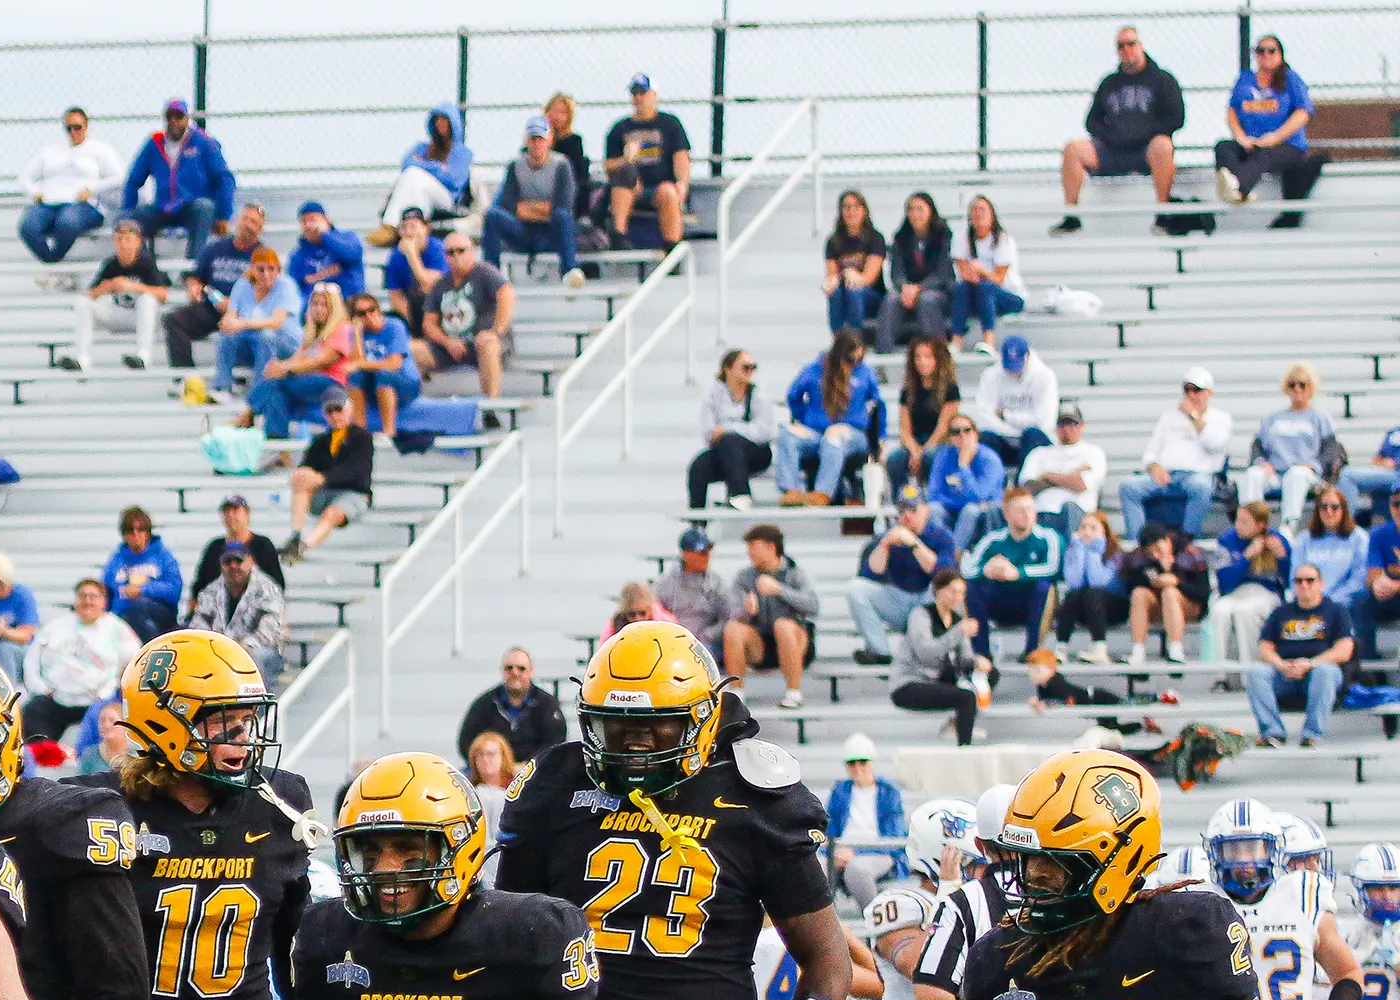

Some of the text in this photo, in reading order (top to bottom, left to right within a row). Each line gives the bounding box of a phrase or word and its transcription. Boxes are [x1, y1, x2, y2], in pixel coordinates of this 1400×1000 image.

[360, 812, 395, 823] Riddell
[1004, 829, 1033, 844] Riddell
[87, 818, 137, 870] 59
[152, 857, 255, 880] BROCKPORT
[581, 837, 721, 958] 23
[872, 901, 899, 926] 50
[151, 883, 261, 999] 10
[1226, 921, 1252, 977] 2
